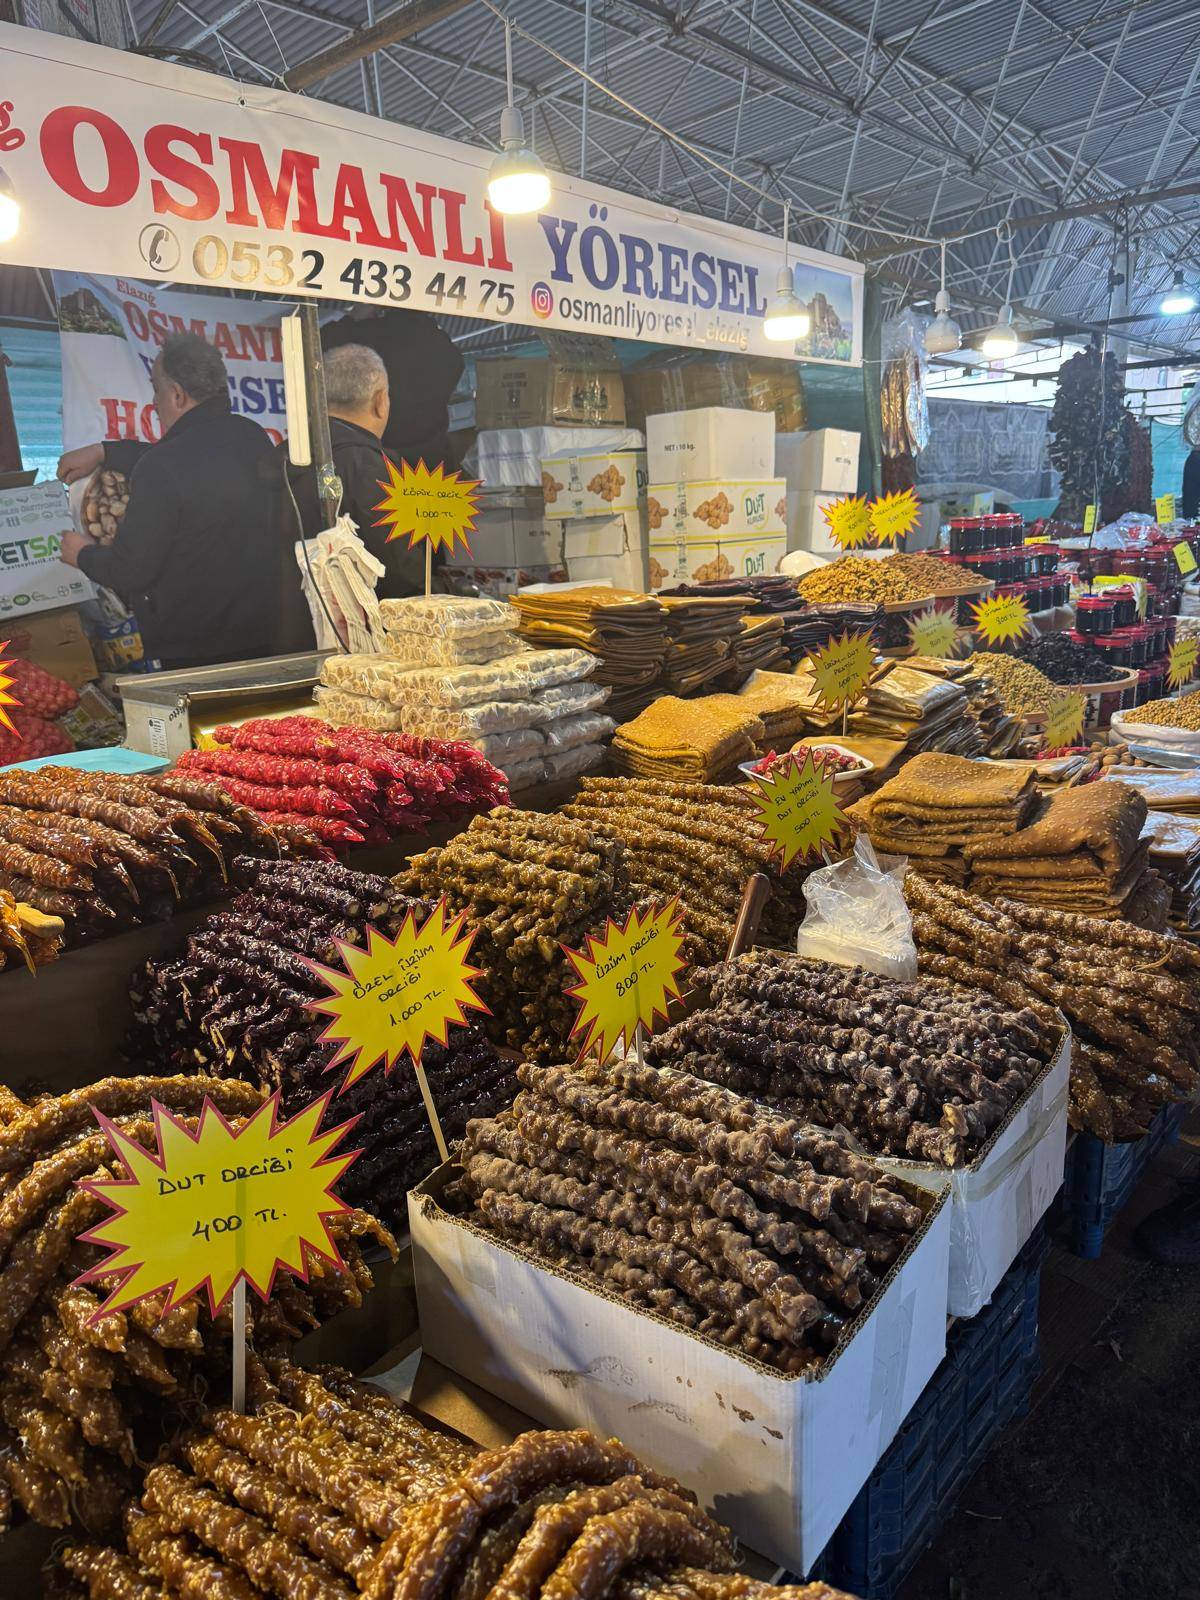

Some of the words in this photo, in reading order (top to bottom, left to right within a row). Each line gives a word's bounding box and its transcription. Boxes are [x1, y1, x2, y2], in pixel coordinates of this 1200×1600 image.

[40, 106, 513, 271] OSMANLI
[538, 203, 768, 318] YÖRESEL
[193, 235, 324, 290] 0532
[340, 258, 411, 302] 433
[425, 272, 467, 308] 44
[479, 279, 515, 316] 75
[0, 534, 61, 565] ETSA
[774, 794, 787, 807] EV
[777, 807, 793, 821] DUT
[794, 818, 811, 834] 500
[353, 974, 393, 999] ÖZEL
[398, 945, 435, 971] ÜZÜM
[596, 952, 627, 979] ÜZÜM
[615, 971, 639, 997] 800
[389, 1001, 423, 1027] 1.000
[158, 1173, 206, 1196] DUT
[192, 1215, 243, 1242] 400
[255, 1208, 287, 1223] TL.
